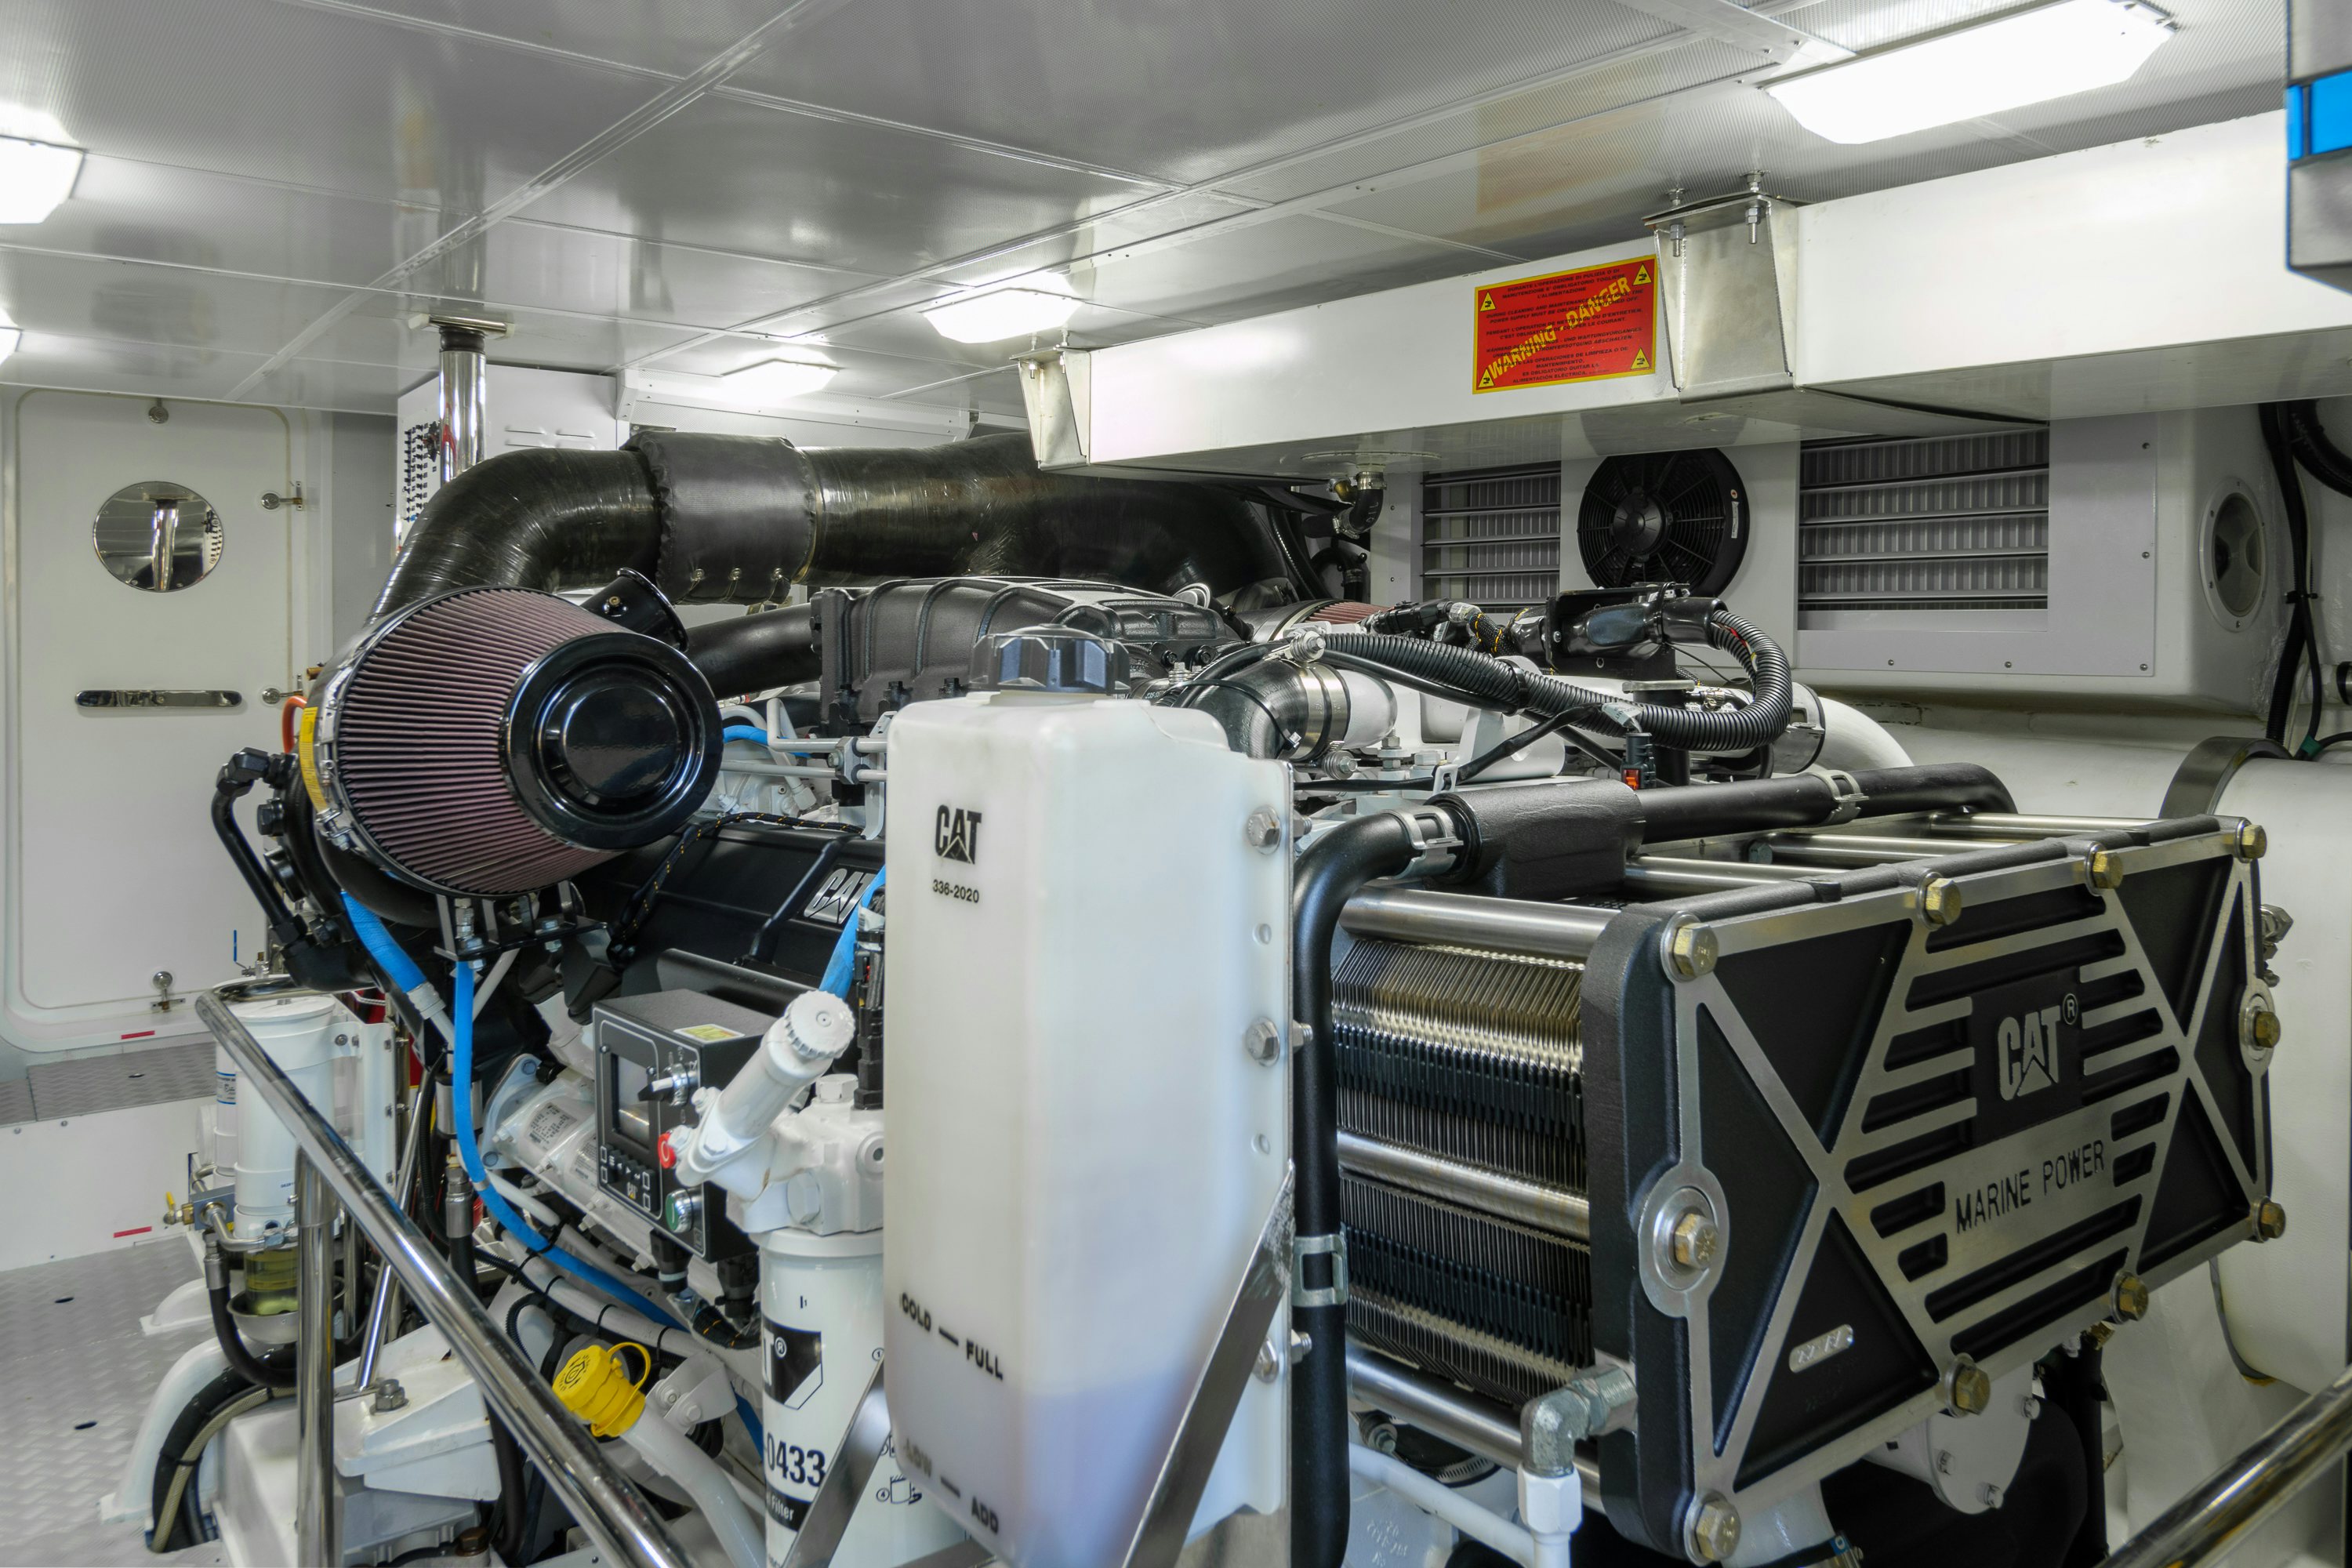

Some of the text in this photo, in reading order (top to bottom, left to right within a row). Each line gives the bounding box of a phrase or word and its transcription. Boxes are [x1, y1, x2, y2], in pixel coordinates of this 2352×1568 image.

[1489, 325, 1556, 379] WARNING
[1566, 277, 1632, 331] DANGER
[1507, 307, 1534, 315] CLEANING
[1548, 298, 1588, 308] MAINTENANCE
[1593, 298, 1624, 307] SWITCHED
[1534, 354, 1573, 362] OPERACIONES
[935, 804, 982, 865] CAT
[804, 868, 877, 924] CAT
[932, 880, 980, 903] 336-2020
[1955, 1139, 2106, 1233] MARINE POWER
[902, 1291, 1004, 1381] COLD FULL
[770, 1493, 794, 1522] Filter
[904, 1436, 1000, 1535] LOW ADD
